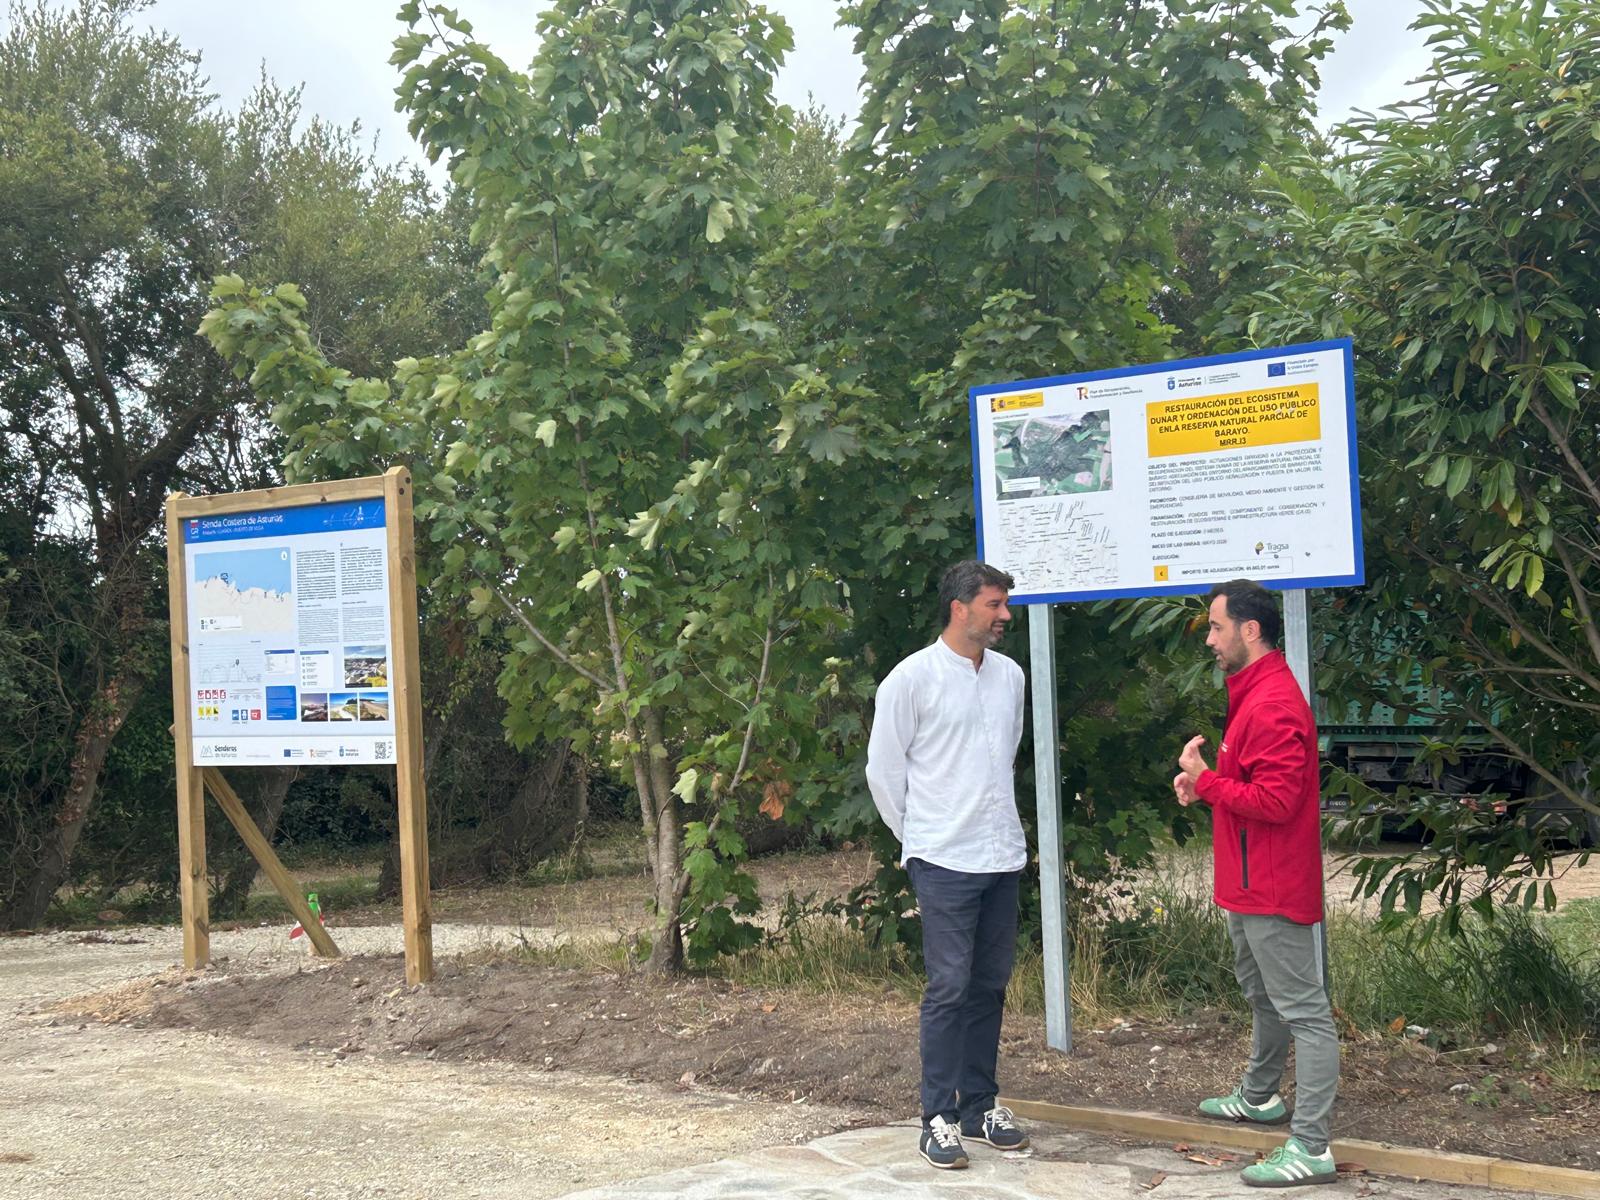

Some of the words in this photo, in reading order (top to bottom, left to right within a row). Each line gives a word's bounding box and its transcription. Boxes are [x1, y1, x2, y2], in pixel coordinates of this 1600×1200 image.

[1178, 380, 1202, 388] Asturias
[1165, 398, 1226, 413] RESTAURACIÓN
[1228, 397, 1244, 406] DEL
[1246, 391, 1300, 404] ECOSISTEMA
[1150, 415, 1178, 425] DUNAR
[1187, 407, 1240, 420] ORDENACIÓN
[1242, 405, 1258, 414] DEL
[1259, 403, 1277, 412] USO
[1280, 398, 1317, 410] PÚBLICO
[1181, 420, 1218, 431] RESERVA
[1220, 416, 1258, 427] NATURAL
[1259, 412, 1295, 423] PARCIAL
[1296, 411, 1308, 419] DE
[202, 520, 222, 528] Senda
[222, 518, 247, 527] Costera
[247, 517, 256, 525] de
[257, 514, 284, 523] Asturias
[1266, 543, 1289, 552] Tragsa
